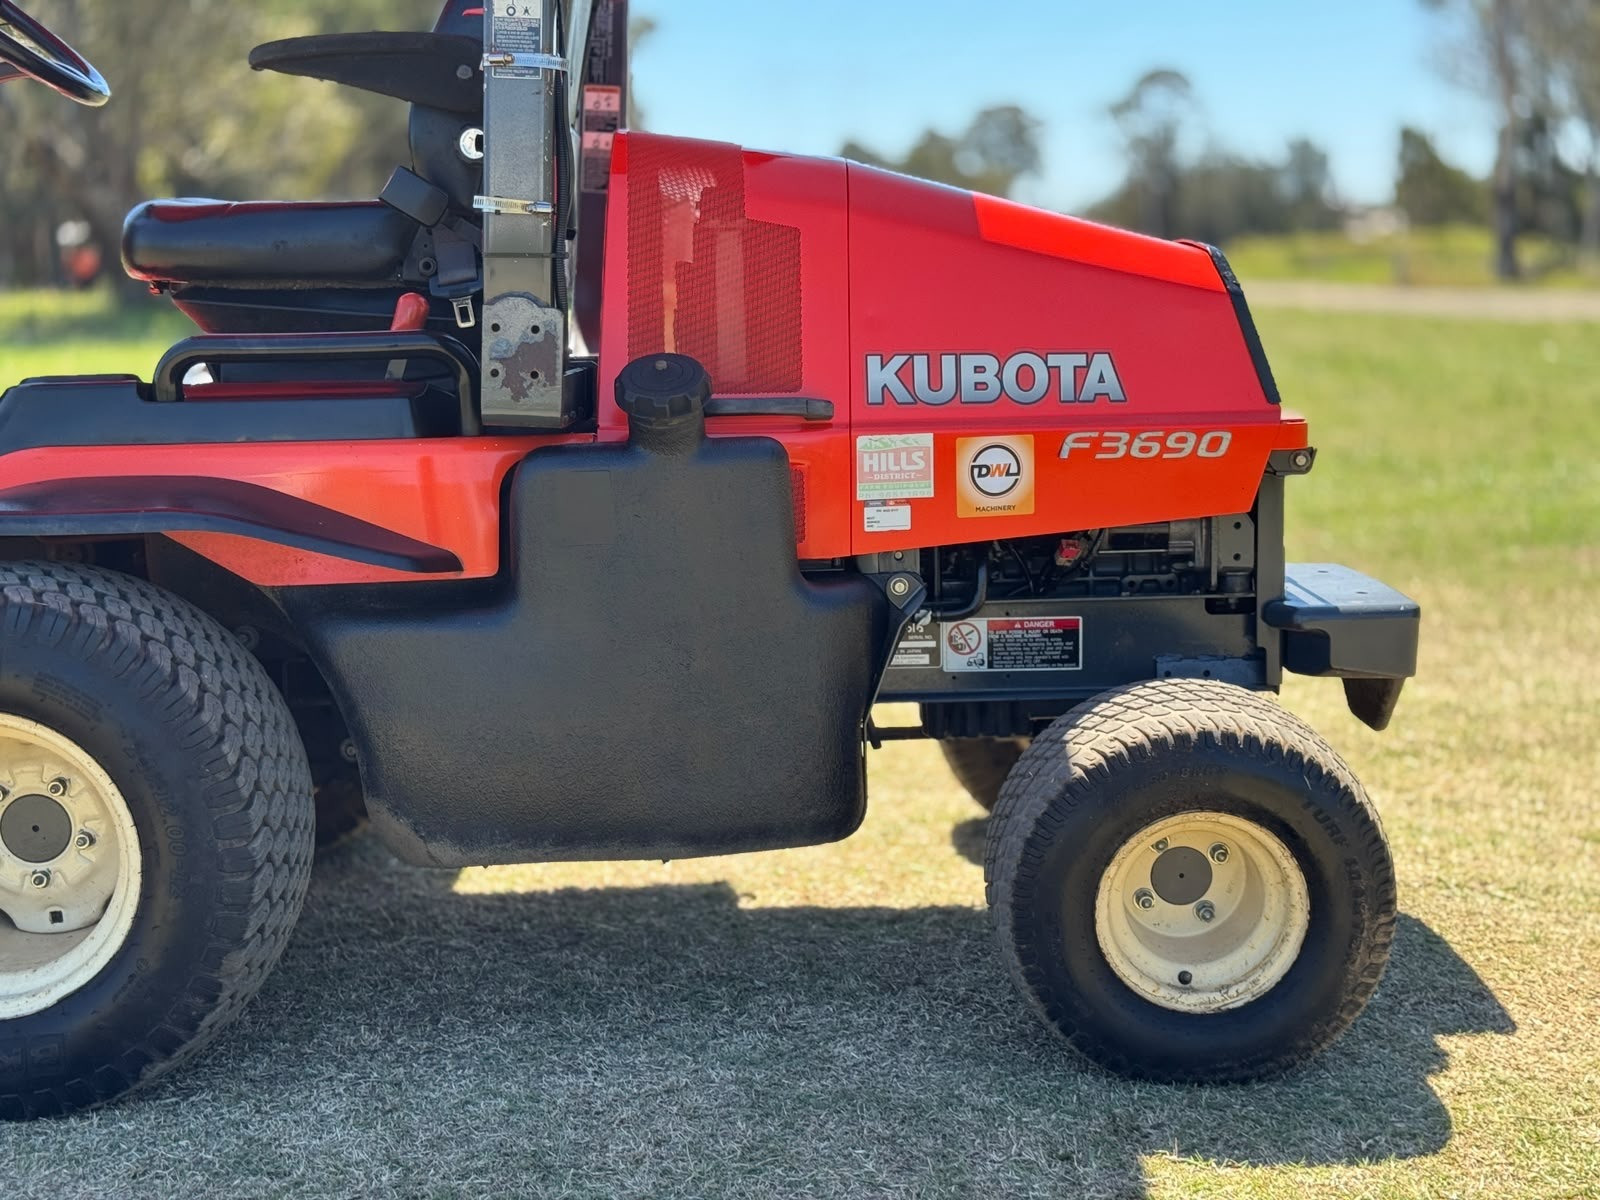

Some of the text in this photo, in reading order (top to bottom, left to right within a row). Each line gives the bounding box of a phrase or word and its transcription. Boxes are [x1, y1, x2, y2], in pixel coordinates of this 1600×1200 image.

[865, 351, 1127, 406] KUBOTA
[1059, 430, 1233, 460] F3690
[863, 450, 926, 473] HILLS
[873, 471, 916, 480] DISTRICT
[971, 462, 1020, 478] DWL
[975, 504, 1017, 513] MACHINERY
[1023, 620, 1055, 628] DANGER
